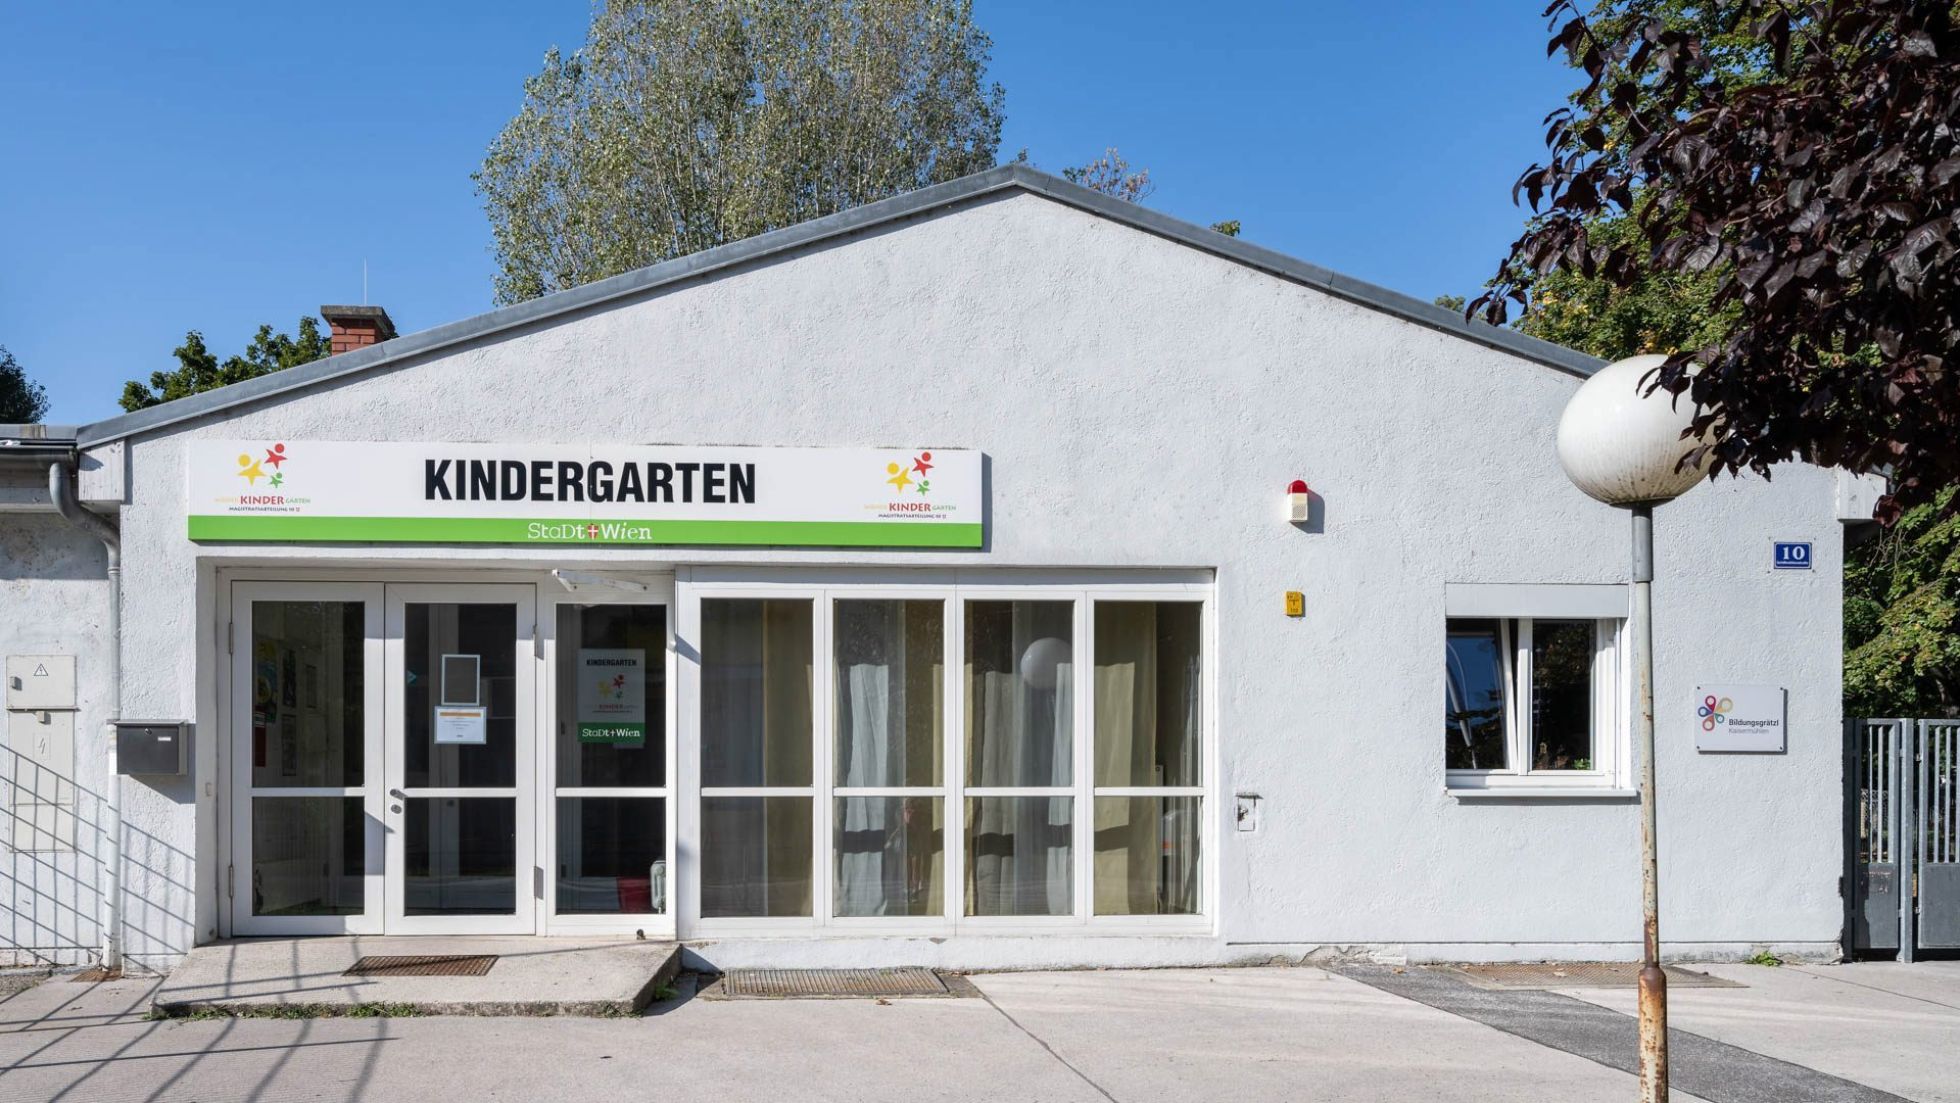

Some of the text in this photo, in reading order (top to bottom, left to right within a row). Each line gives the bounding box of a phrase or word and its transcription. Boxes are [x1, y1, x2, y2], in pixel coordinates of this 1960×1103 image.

[425, 459, 755, 503] KINDERGARTEN
[240, 495, 284, 505] KINDER
[889, 502, 931, 512] KINDER
[601, 522, 652, 540] Wien
[1783, 546, 1805, 560] 10
[586, 658, 638, 667] KINDERGARTEN
[1728, 719, 1779, 727] Bildungsgrätzl
